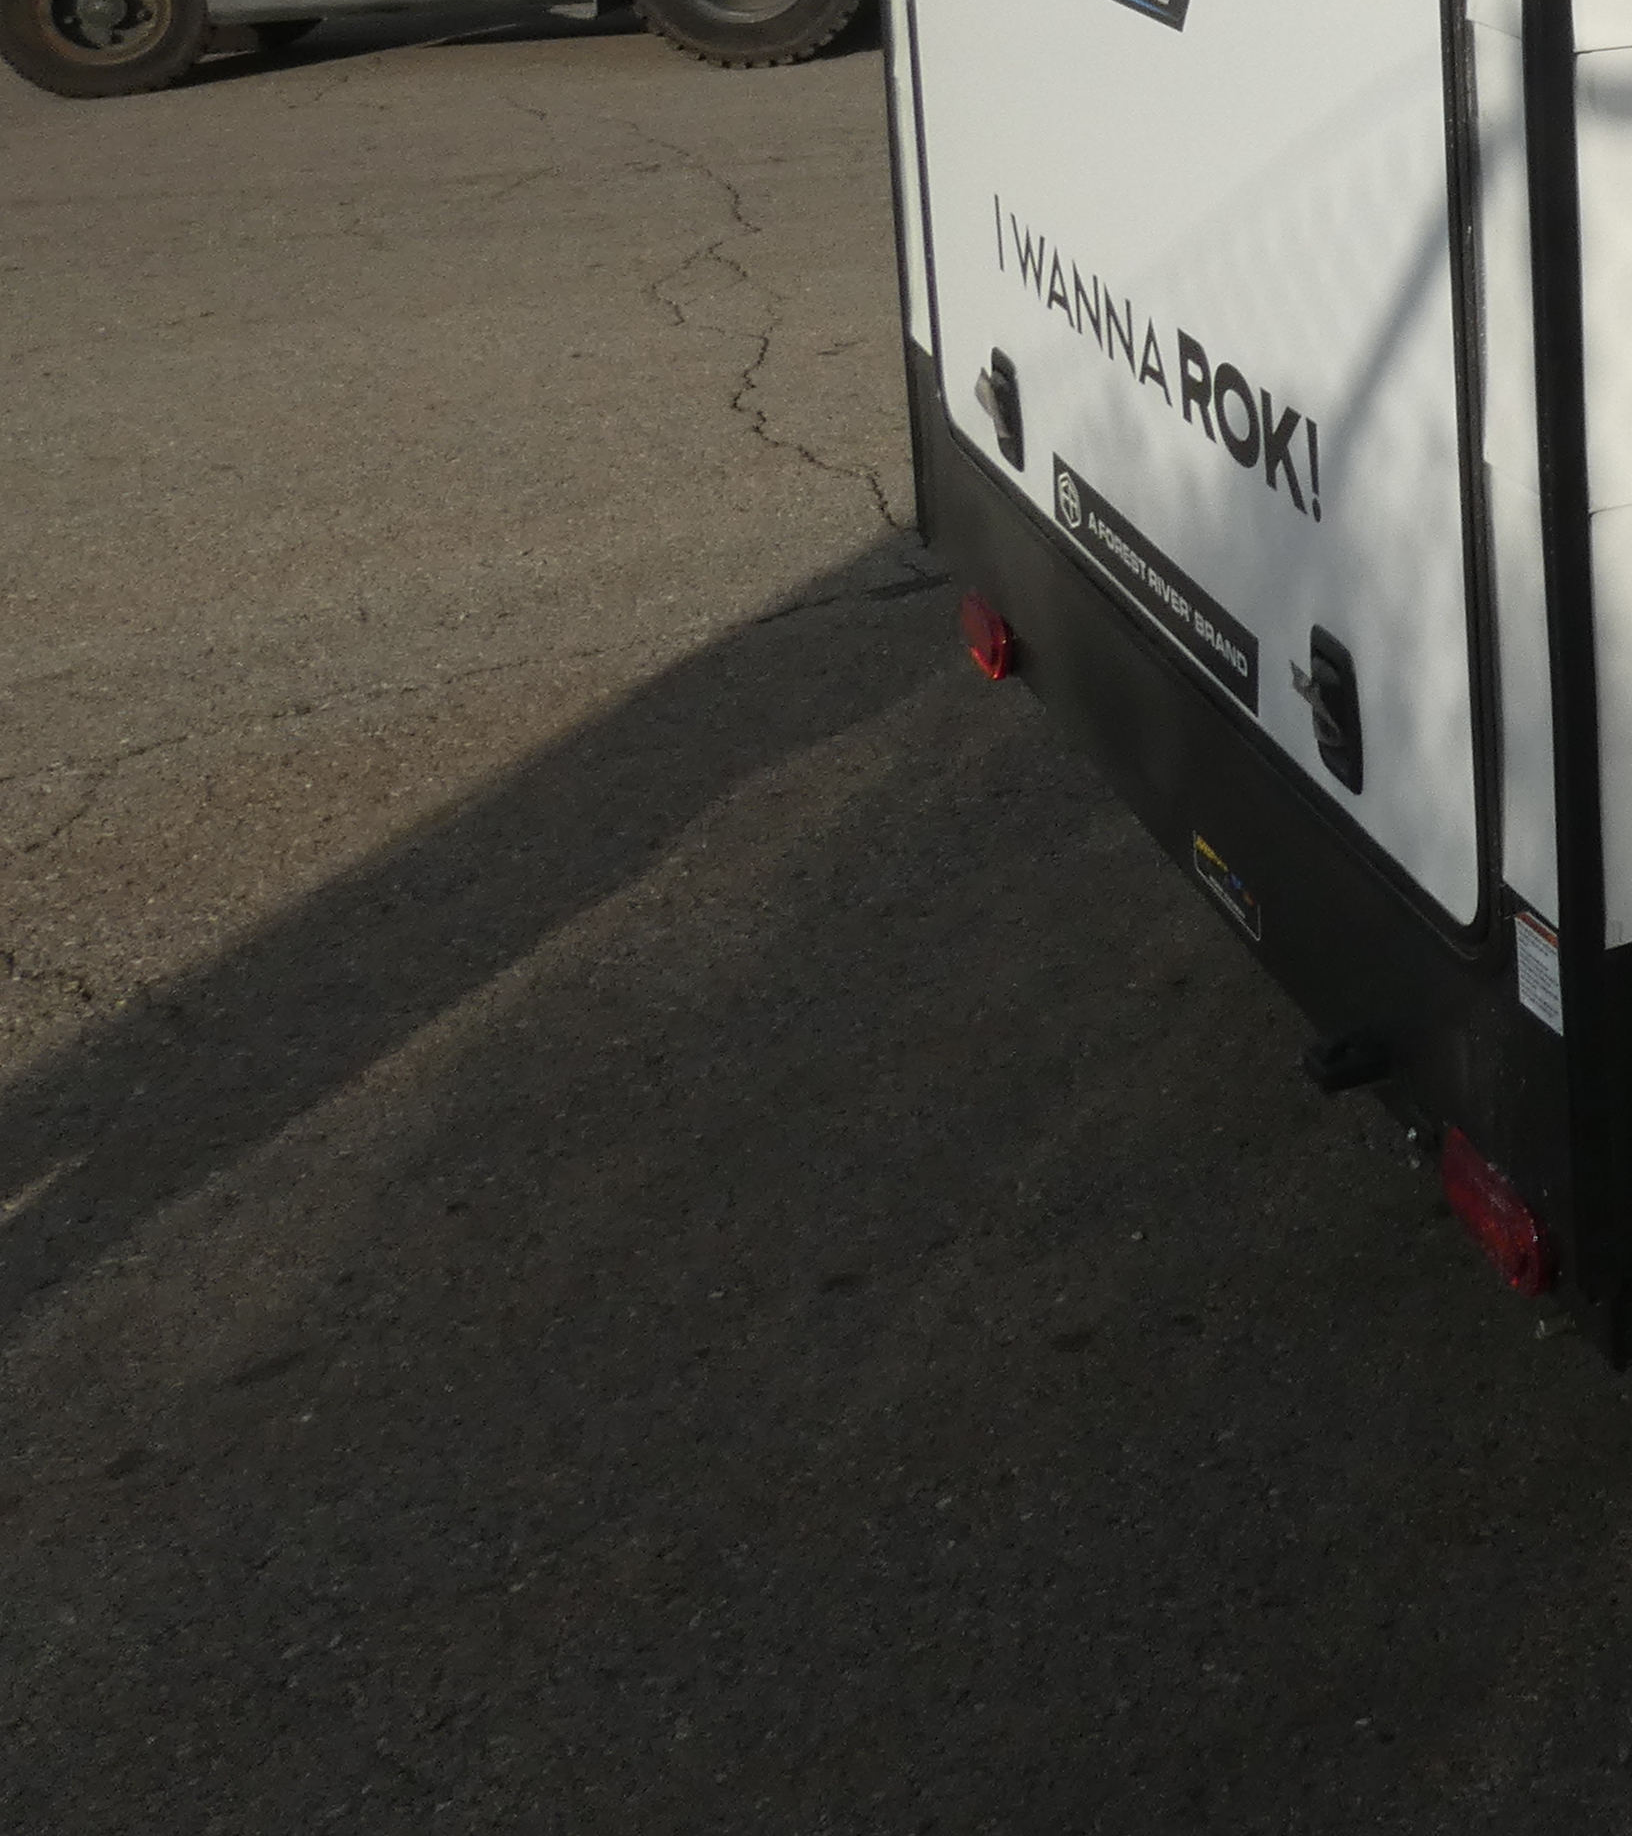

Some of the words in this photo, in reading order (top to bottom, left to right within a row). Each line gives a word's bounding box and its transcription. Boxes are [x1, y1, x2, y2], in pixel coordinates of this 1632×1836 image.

[994, 194, 1004, 271] I
[1010, 212, 1173, 408] WANNA
[1176, 327, 1322, 523] ROK!
[1088, 511, 1098, 534] A
[1098, 522, 1146, 580] FOREST
[1148, 567, 1190, 622] RIVER
[1194, 610, 1248, 677] BRAND
